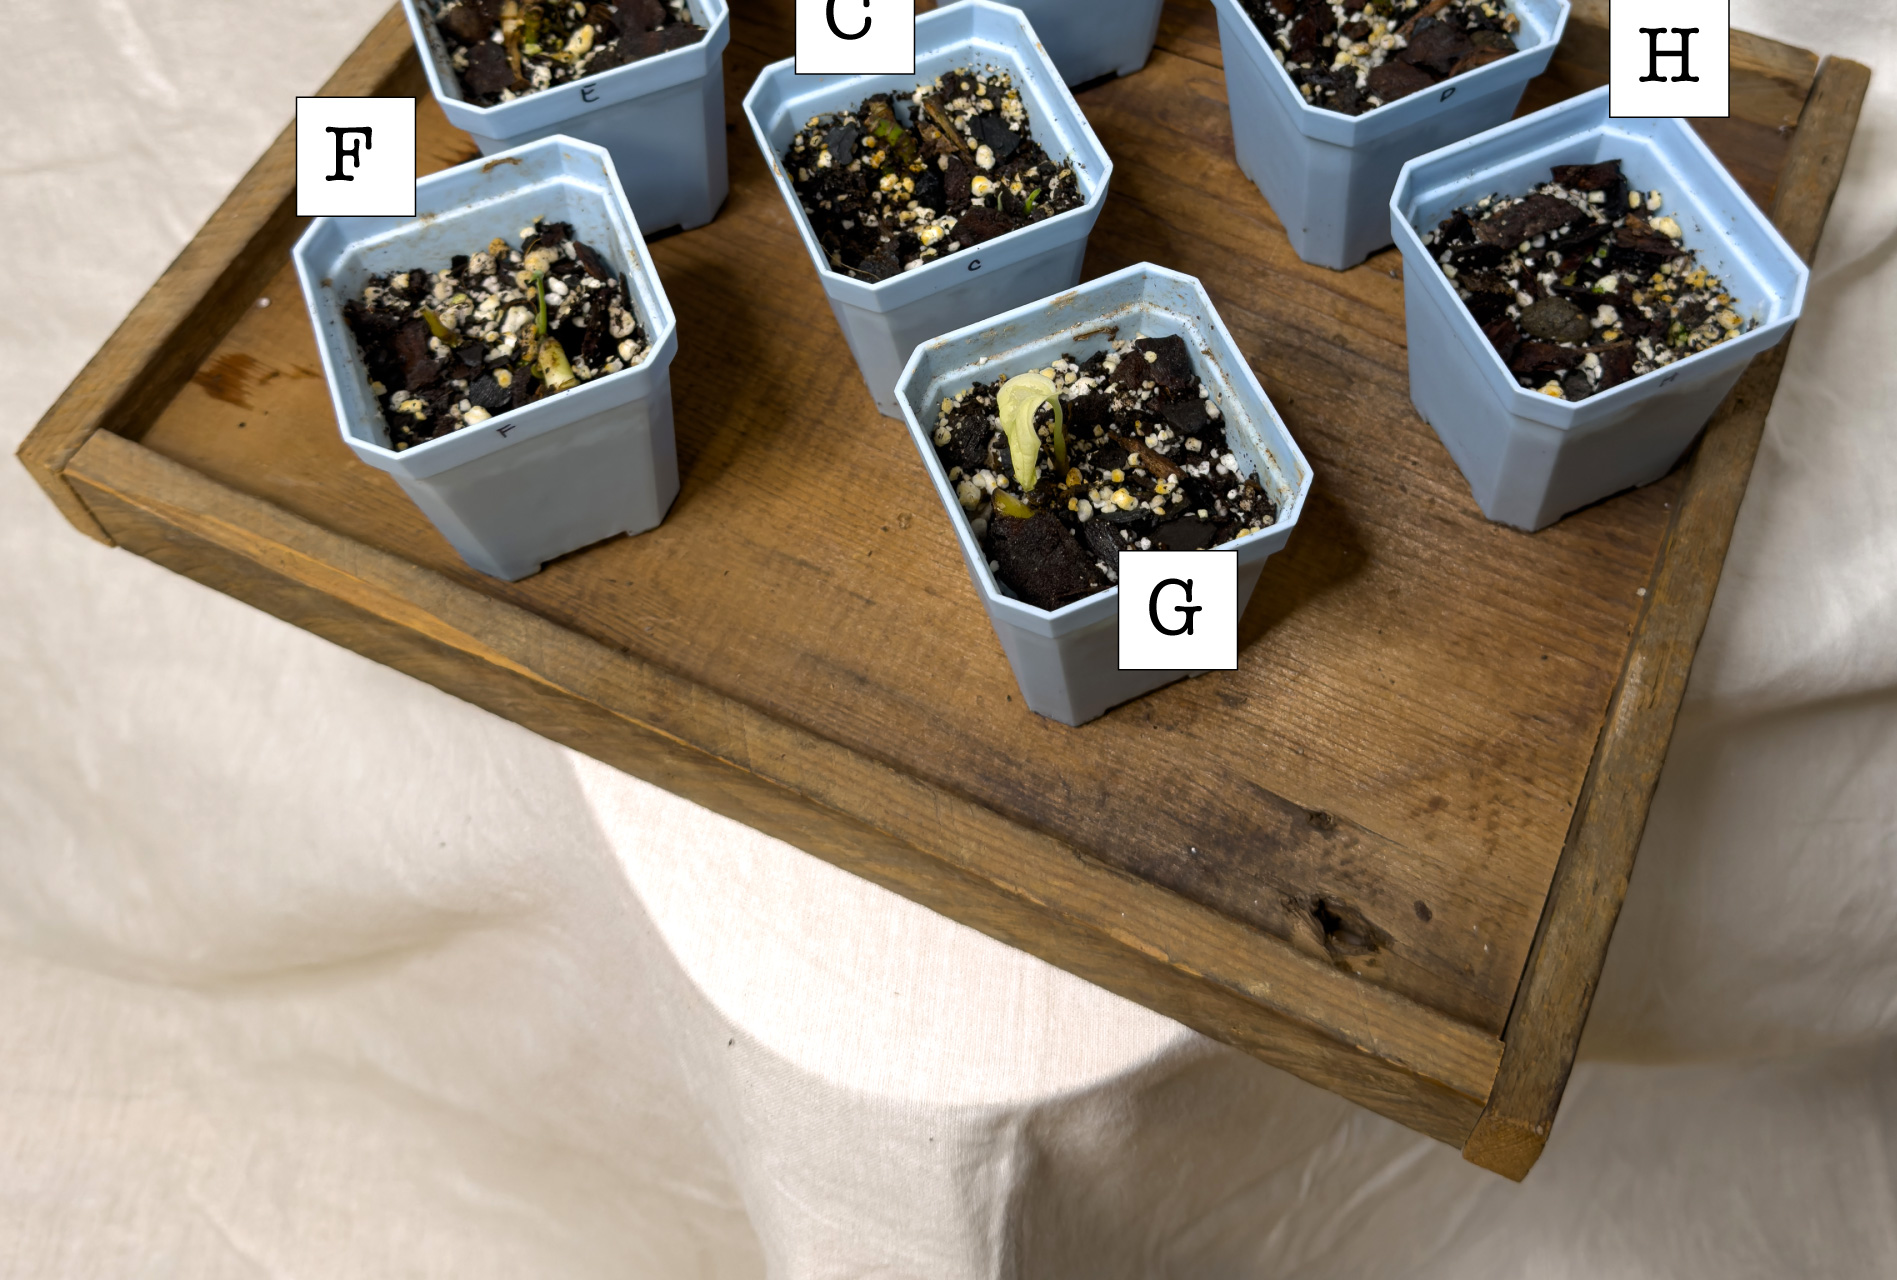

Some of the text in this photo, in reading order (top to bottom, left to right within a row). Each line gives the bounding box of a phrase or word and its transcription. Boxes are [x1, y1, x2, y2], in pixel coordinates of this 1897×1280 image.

[580, 83, 600, 104] E
[1440, 87, 1456, 103] D
[967, 258, 982, 272] C
[495, 423, 516, 438] F
